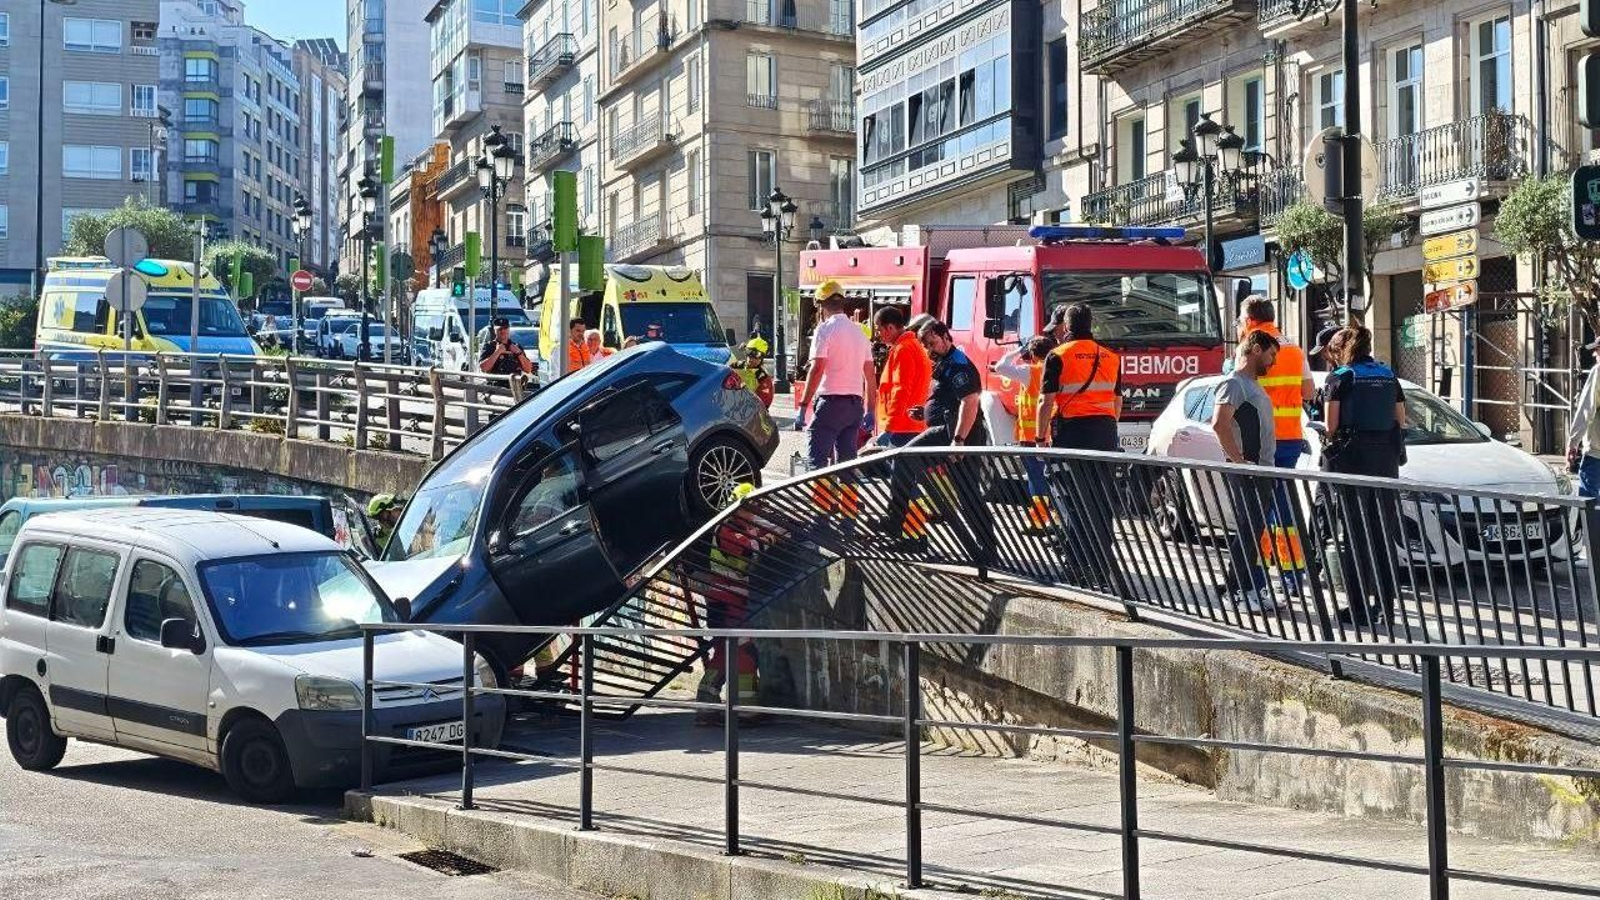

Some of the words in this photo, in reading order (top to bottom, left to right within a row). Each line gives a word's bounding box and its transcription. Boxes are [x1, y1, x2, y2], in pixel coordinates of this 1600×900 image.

[1121, 388, 1160, 398] MAN
[1121, 437, 1143, 447] 0439
[416, 727, 445, 741] 8247
